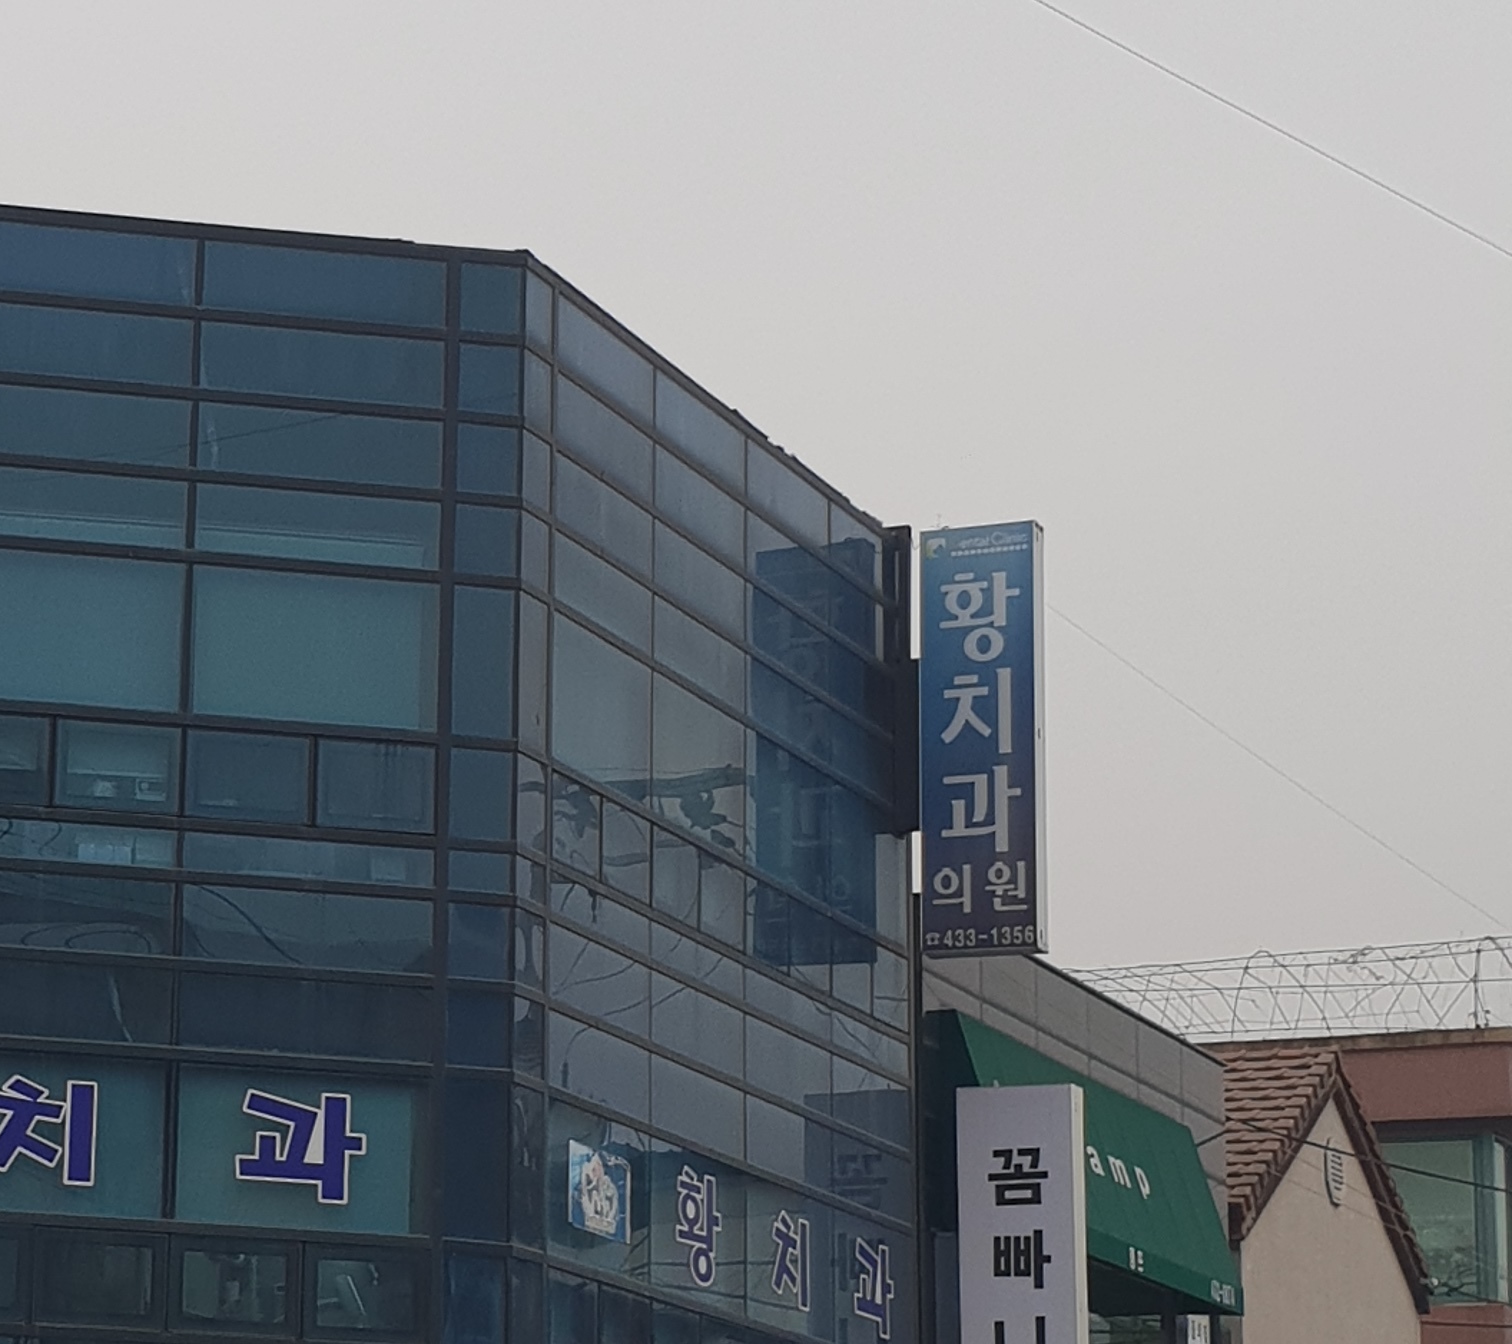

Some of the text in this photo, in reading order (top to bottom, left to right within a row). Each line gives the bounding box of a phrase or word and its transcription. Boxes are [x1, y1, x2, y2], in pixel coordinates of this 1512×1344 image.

[939, 571, 1021, 853] 황치과
[932, 861, 1028, 914] 의원
[943, 925, 1034, 949] 433-1356
[1086, 1145, 1151, 1200] amp
[676, 1164, 894, 1341] 황치과
